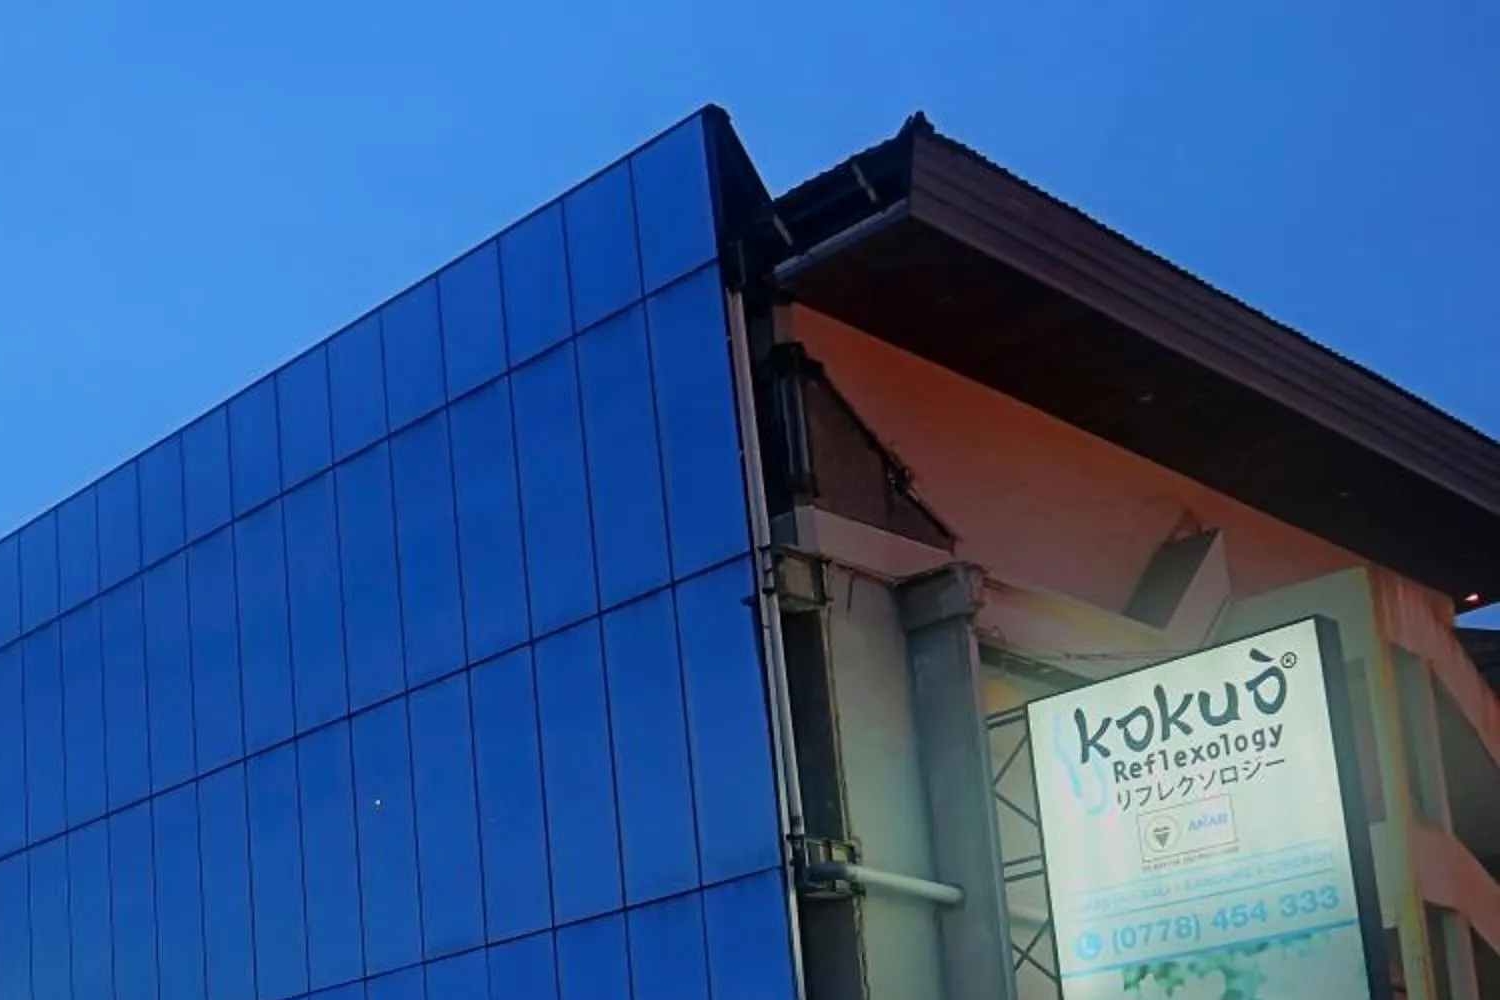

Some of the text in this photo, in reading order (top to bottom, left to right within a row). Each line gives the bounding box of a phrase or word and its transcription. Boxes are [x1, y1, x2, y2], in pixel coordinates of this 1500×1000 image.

[1113, 721, 1284, 784] Reflexology
[1117, 757, 1286, 812] リフレクソロジー
[1110, 885, 1339, 954] (0778) 454 333
